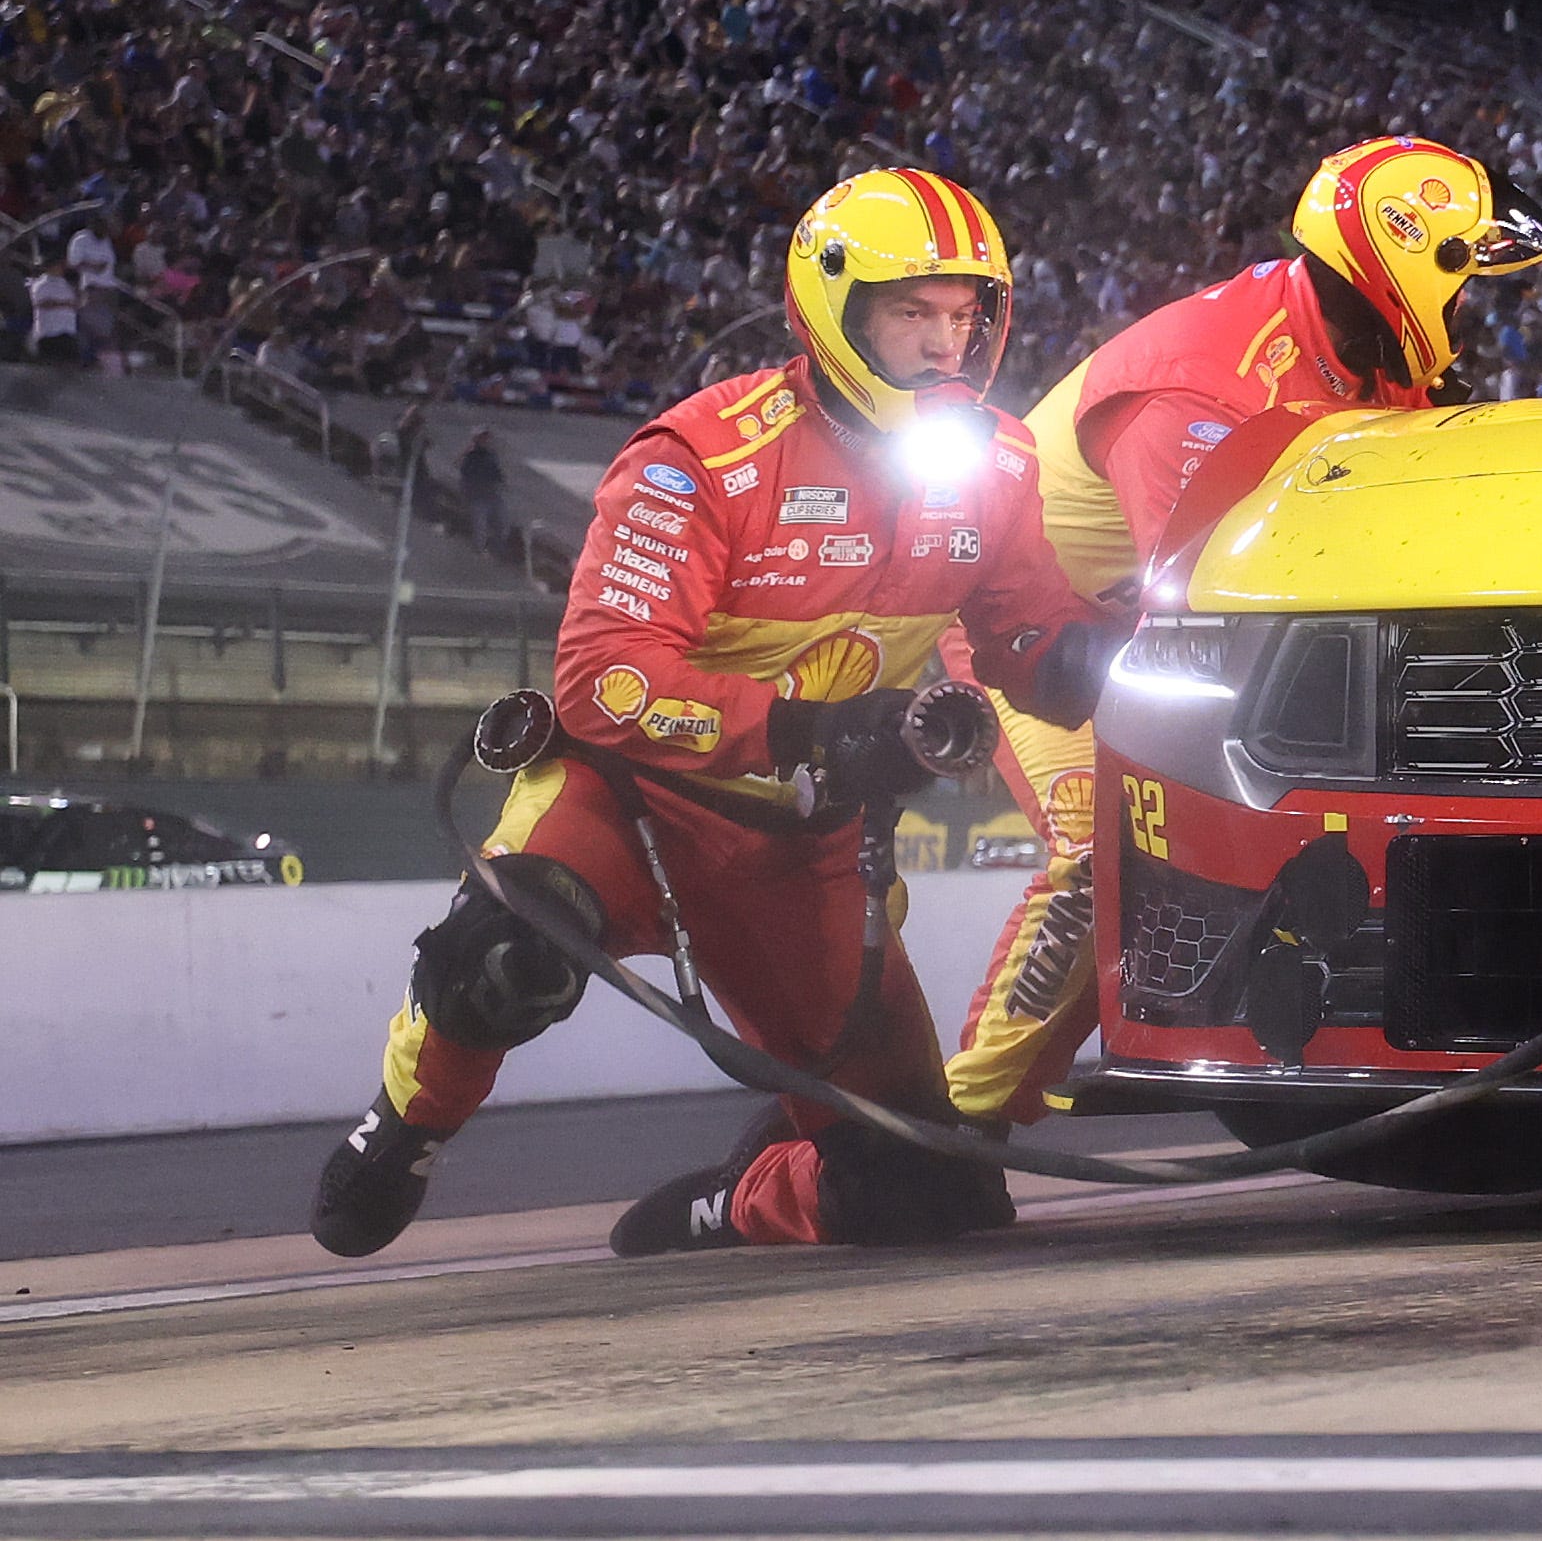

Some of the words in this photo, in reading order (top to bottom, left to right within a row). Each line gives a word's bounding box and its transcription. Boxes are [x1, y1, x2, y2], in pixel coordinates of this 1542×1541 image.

[1381, 206, 1424, 242] PENNZOIL
[651, 468, 688, 492] Ford
[724, 470, 758, 493] OMP
[633, 483, 695, 512] RACING
[786, 505, 805, 516] CUP
[805, 504, 836, 516] SERIES
[797, 490, 837, 502] NASCAR
[949, 530, 977, 558] PPG
[613, 543, 671, 582] Mazak
[601, 563, 671, 601] SIEMENS
[1121, 774, 1169, 862] 22
